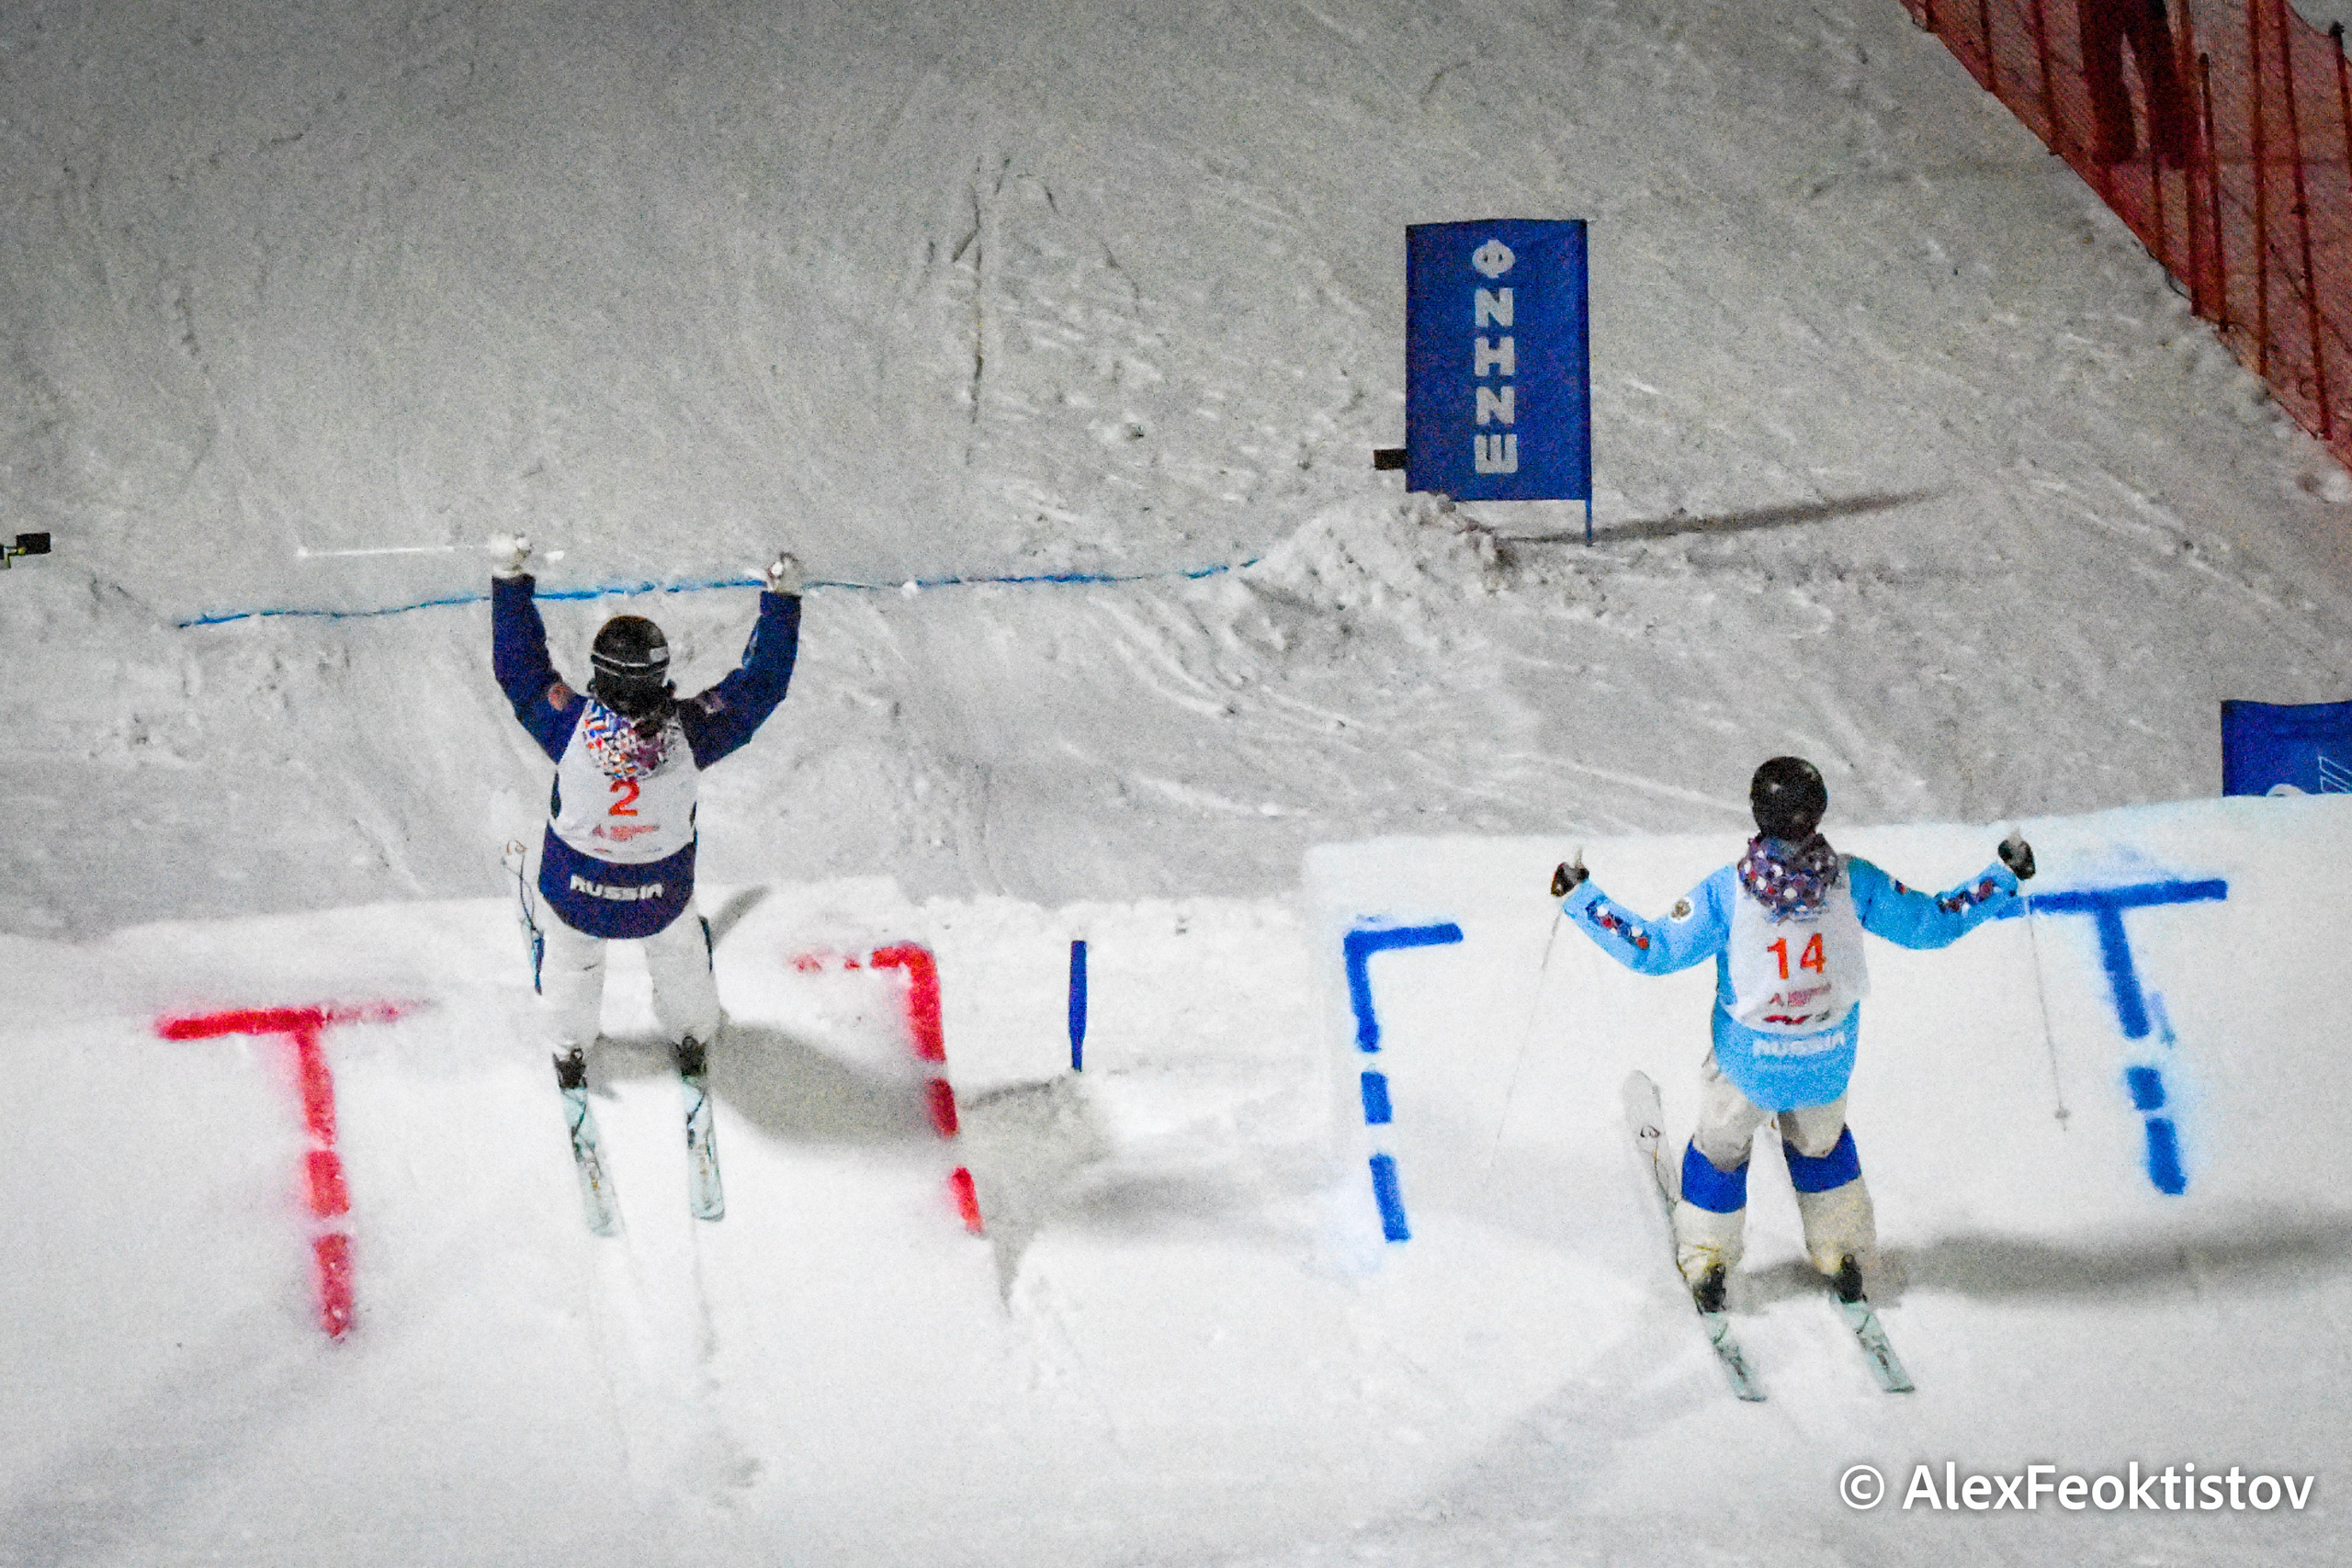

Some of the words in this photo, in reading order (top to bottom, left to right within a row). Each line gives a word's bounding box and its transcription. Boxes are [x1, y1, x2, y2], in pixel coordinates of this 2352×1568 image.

[608, 779, 640, 817] 2
[570, 874, 663, 900] RUSSIA
[1767, 931, 1827, 980] 14
